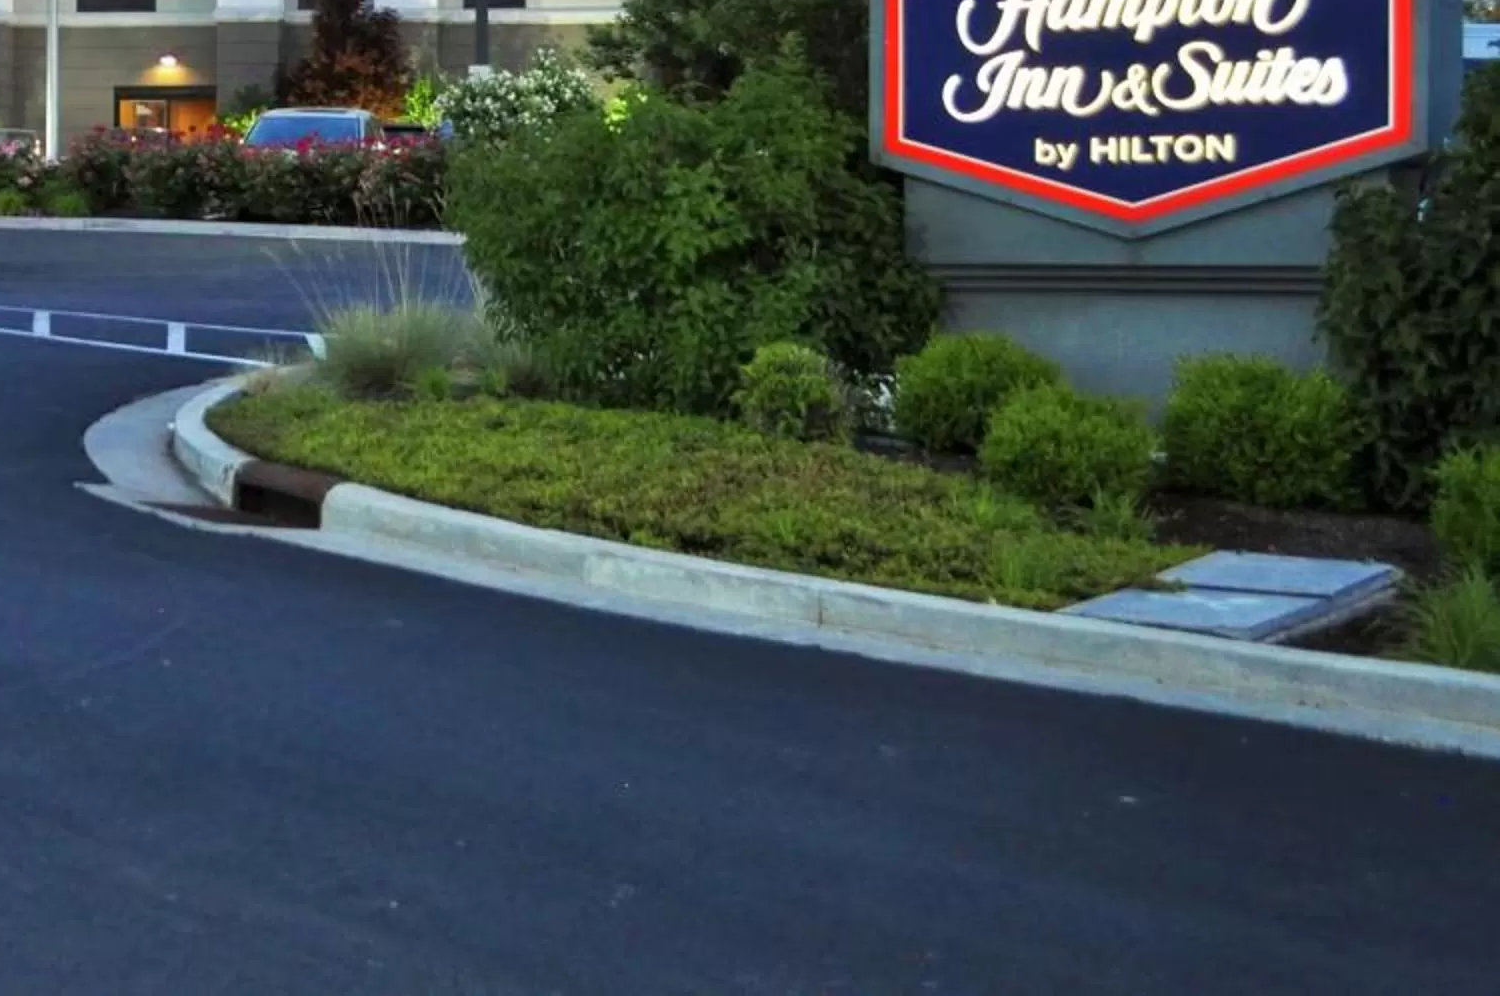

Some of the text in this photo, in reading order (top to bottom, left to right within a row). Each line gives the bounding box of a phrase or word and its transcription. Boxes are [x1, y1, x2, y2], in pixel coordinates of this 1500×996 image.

[942, 40, 1349, 123] Inn & Suites
[1035, 133, 1236, 170] by HILTON
